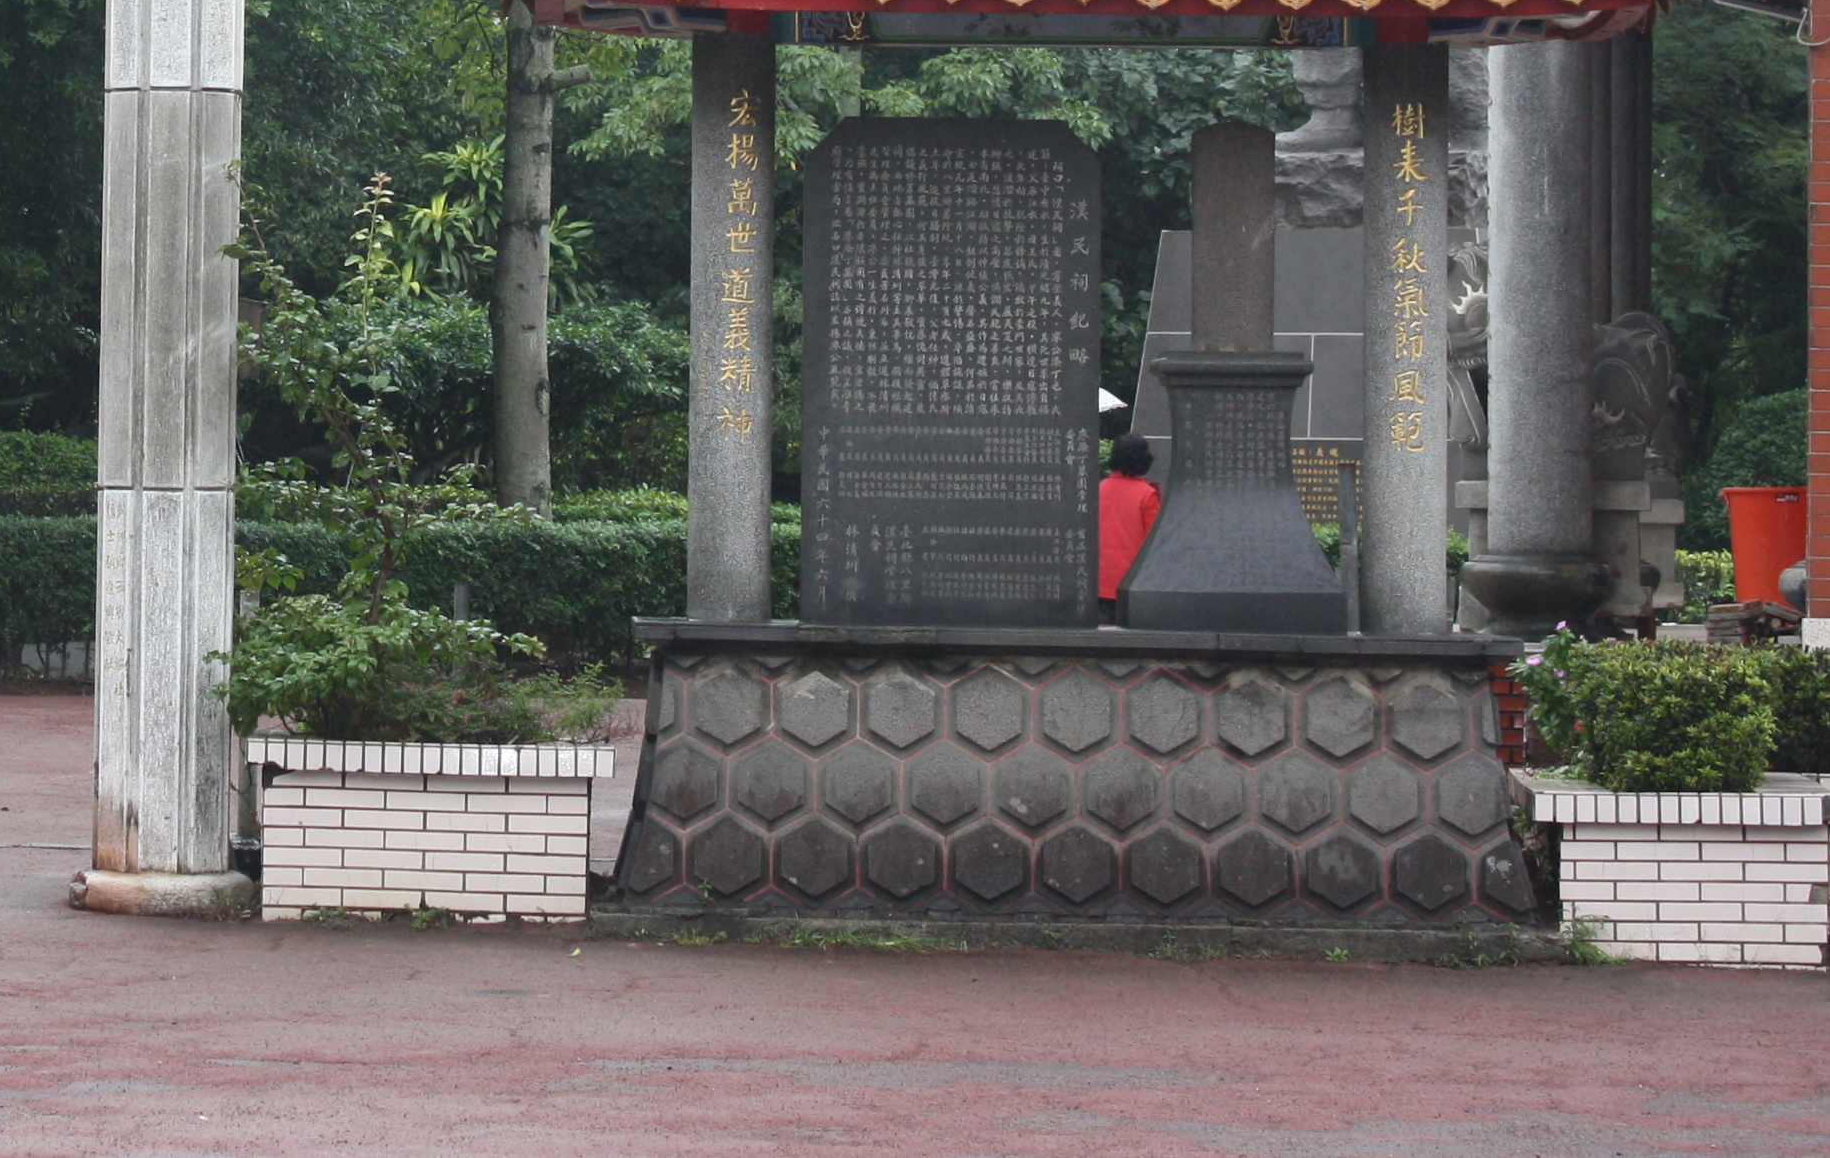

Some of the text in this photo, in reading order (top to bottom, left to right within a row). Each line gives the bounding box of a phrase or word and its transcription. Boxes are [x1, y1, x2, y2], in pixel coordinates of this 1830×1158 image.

[718, 89, 761, 442] 宏揚萬世道義精神
[1069, 199, 1090, 365] 漢民祠紀略
[815, 426, 832, 611] 中華民國六十四年六月
